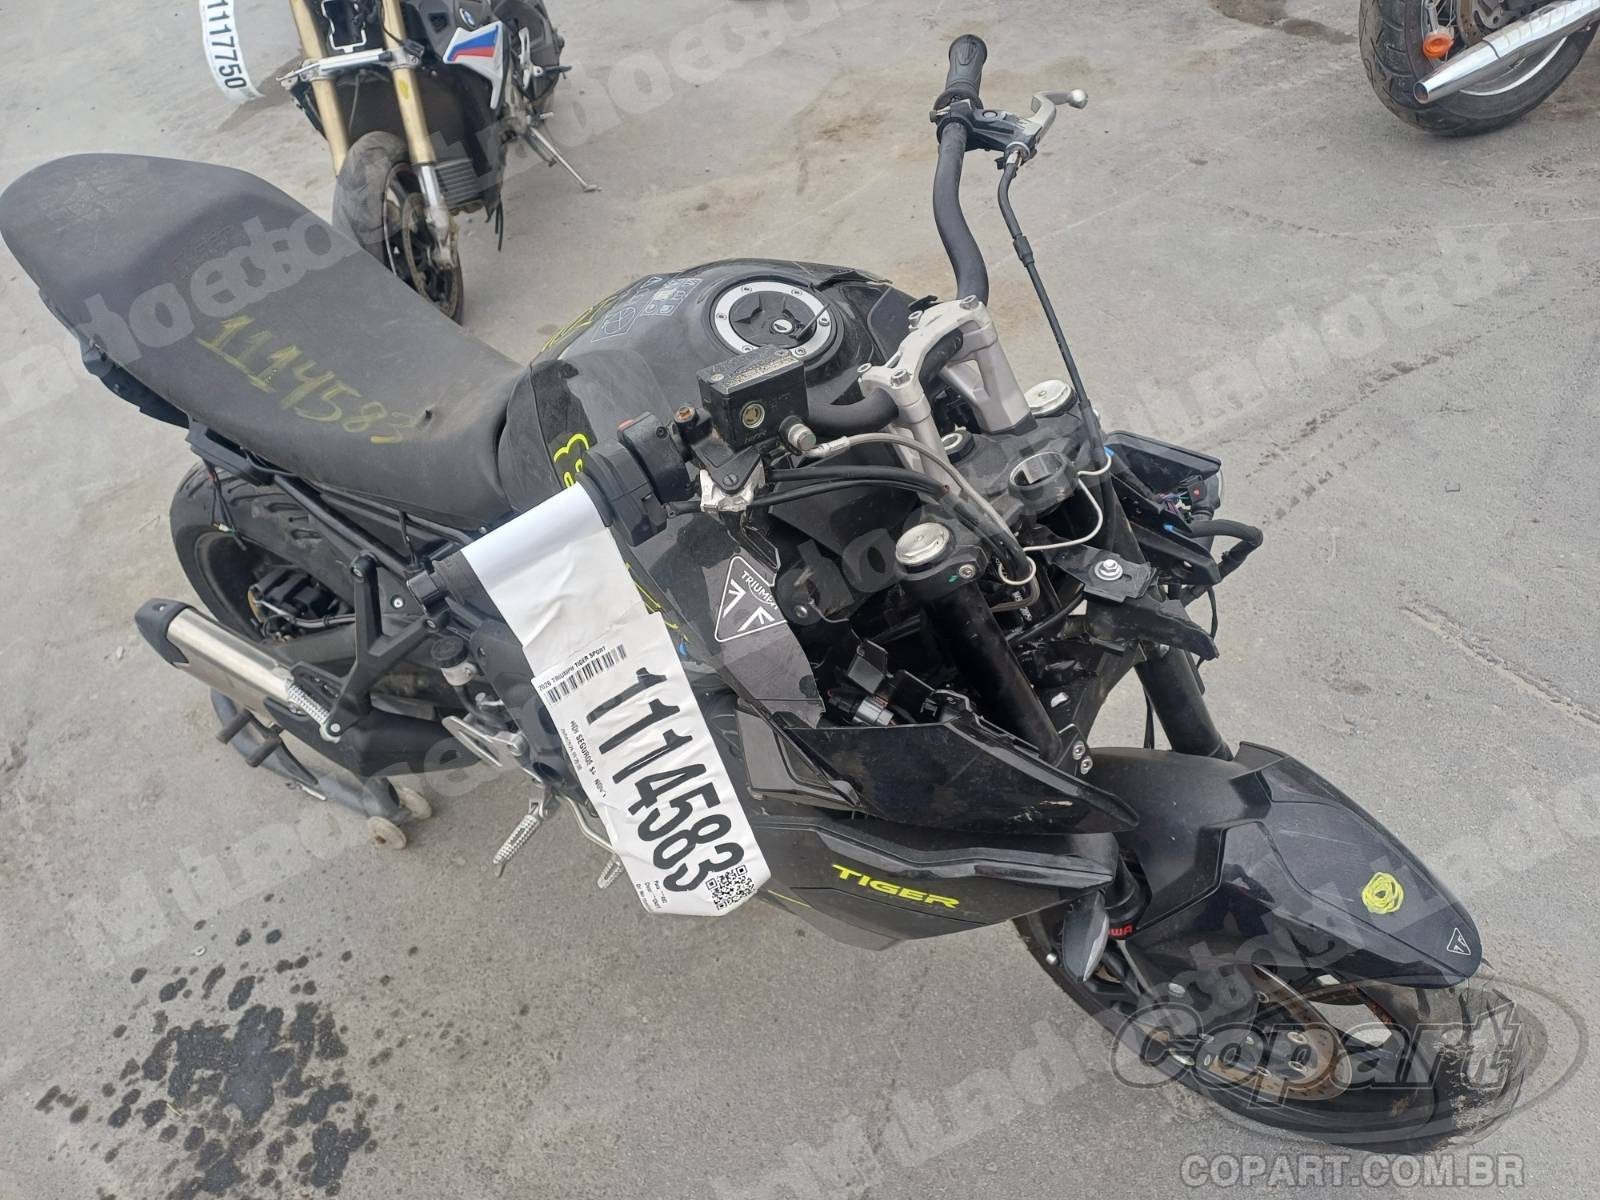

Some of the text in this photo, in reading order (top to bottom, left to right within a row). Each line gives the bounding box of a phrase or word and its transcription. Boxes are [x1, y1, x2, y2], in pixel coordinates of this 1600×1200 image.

[207, 0, 248, 89] 1117750
[551, 665, 575, 683] TRIUMPH
[574, 655, 589, 668] TIGER
[588, 645, 606, 659] SPORT
[576, 734, 594, 766] SEGUROS
[586, 667, 745, 892] 1114583
[831, 864, 960, 909] TIGER
